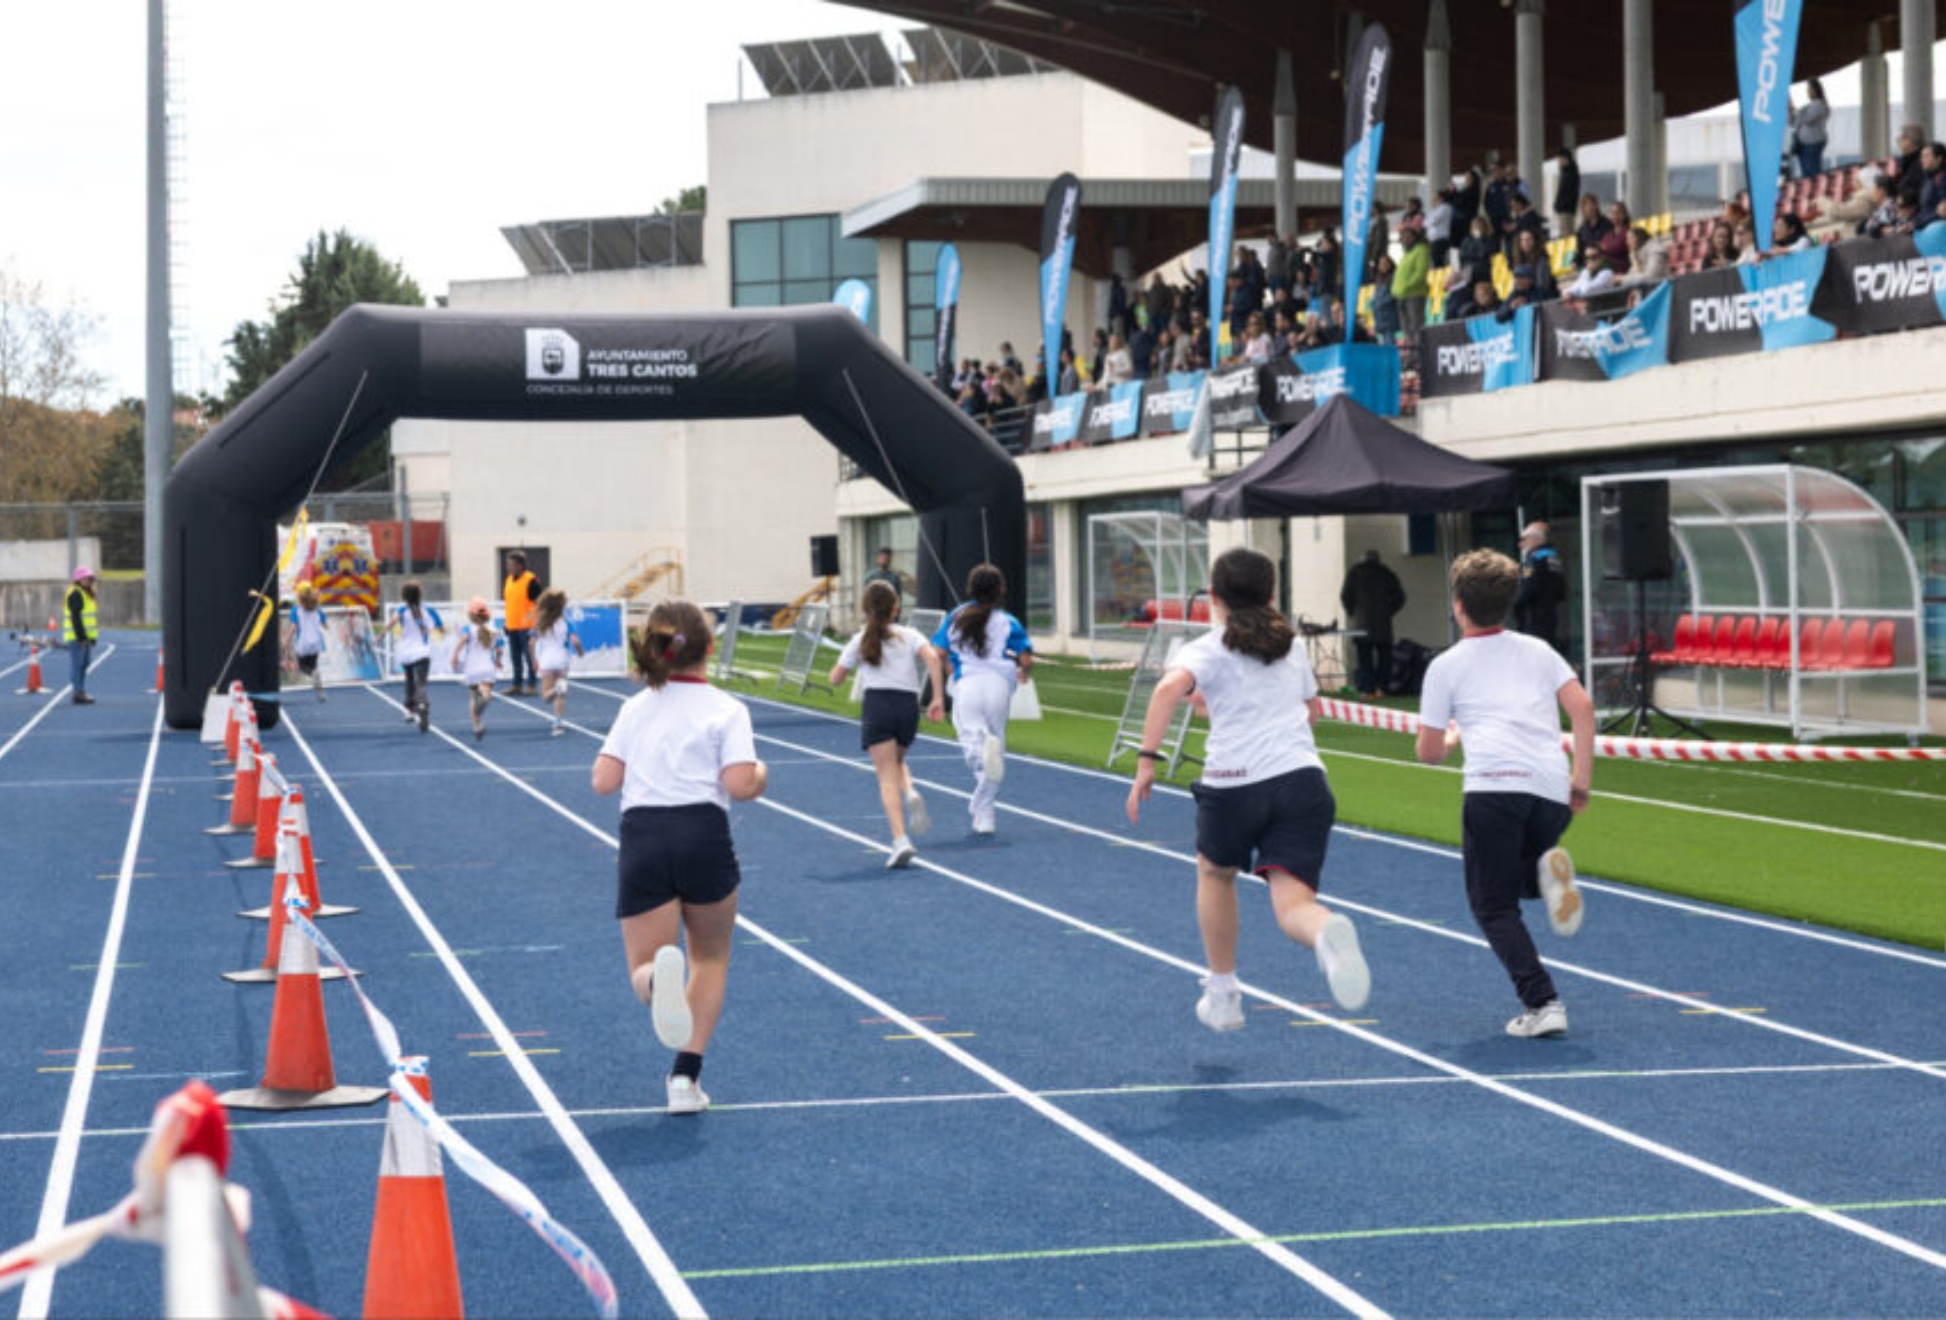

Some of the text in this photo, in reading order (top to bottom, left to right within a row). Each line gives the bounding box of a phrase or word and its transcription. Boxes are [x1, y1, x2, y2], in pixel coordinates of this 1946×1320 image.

[1346, 47, 1388, 246] POWERADE
[1689, 280, 1809, 334] POWERADE
[588, 350, 688, 361] AYUNTAMIENTO
[587, 364, 698, 378] TRES CANTOS
[597, 384, 611, 395] DE
[615, 384, 674, 395] DEPORTES
